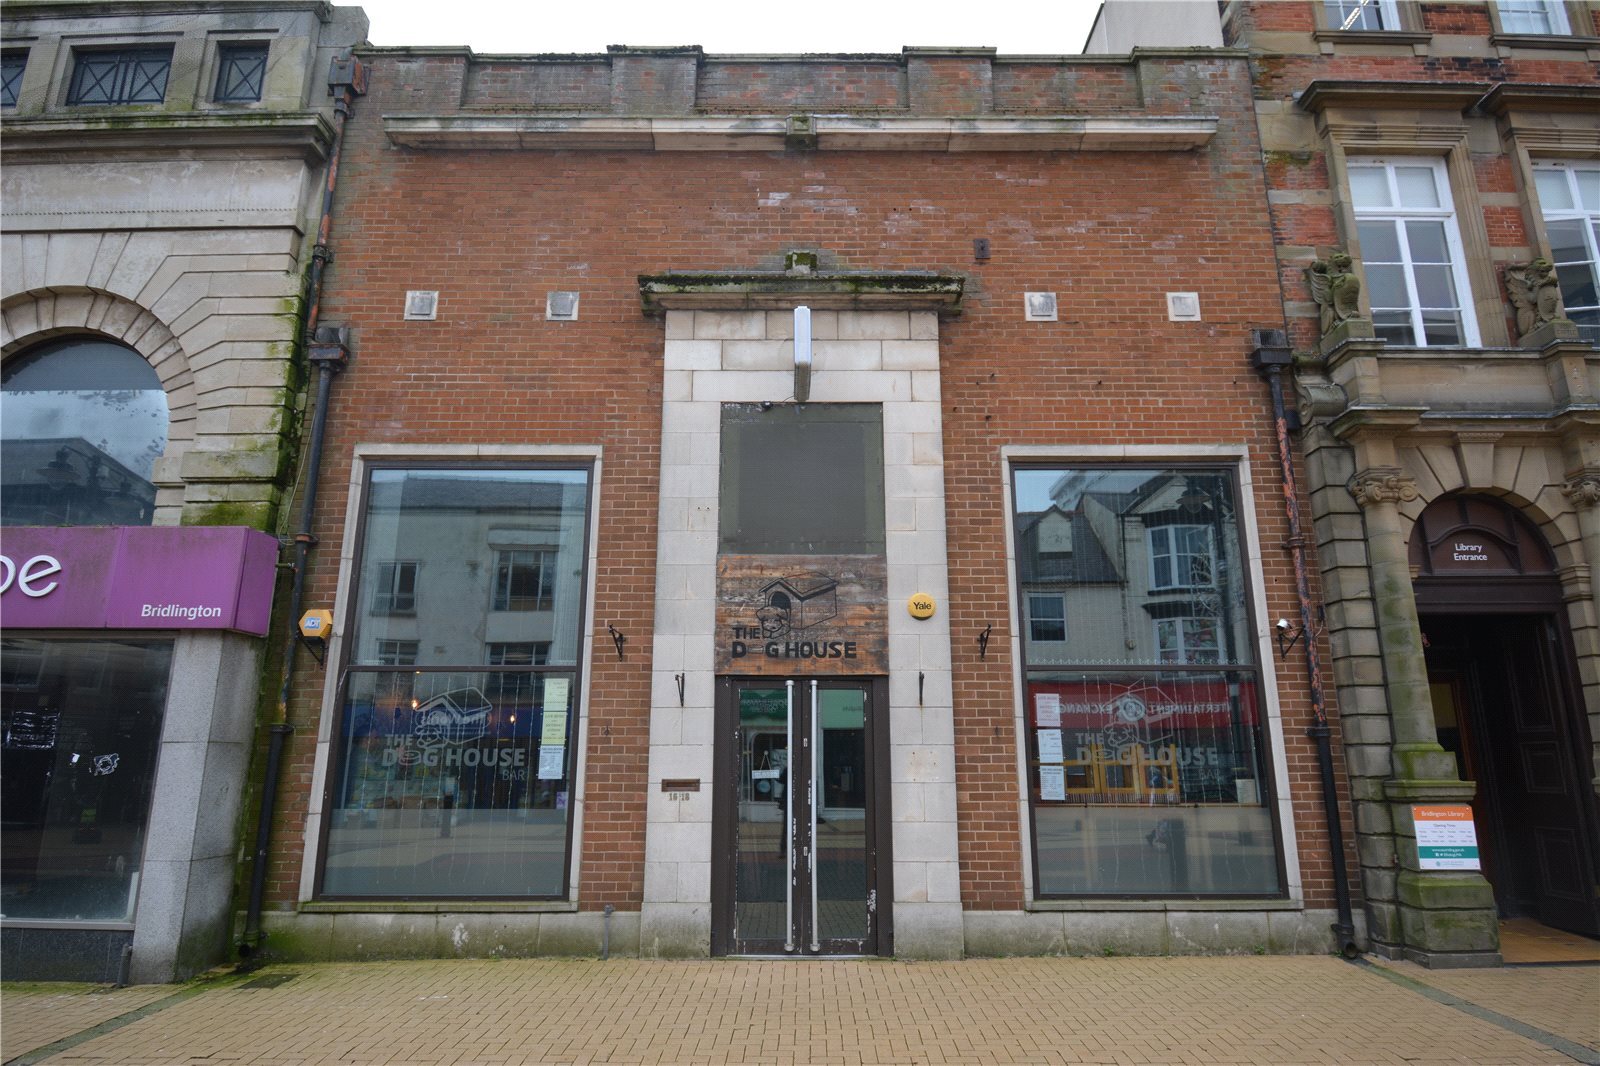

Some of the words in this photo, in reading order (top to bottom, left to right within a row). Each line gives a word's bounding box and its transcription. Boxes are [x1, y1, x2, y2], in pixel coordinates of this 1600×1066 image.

[1454, 543, 1483, 553] Library
[1453, 552, 1488, 561] Entrance
[913, 601, 932, 610] Yale
[141, 604, 222, 620] Bridlington
[732, 627, 761, 639] THE
[732, 641, 779, 659] DG
[785, 641, 857, 659] HOUSE
[385, 734, 413, 746] THE
[1075, 732, 1104, 745] THE
[445, 748, 526, 767] HOUSE
[1138, 746, 1218, 766] HOUSE
[502, 769, 526, 781] BAR
